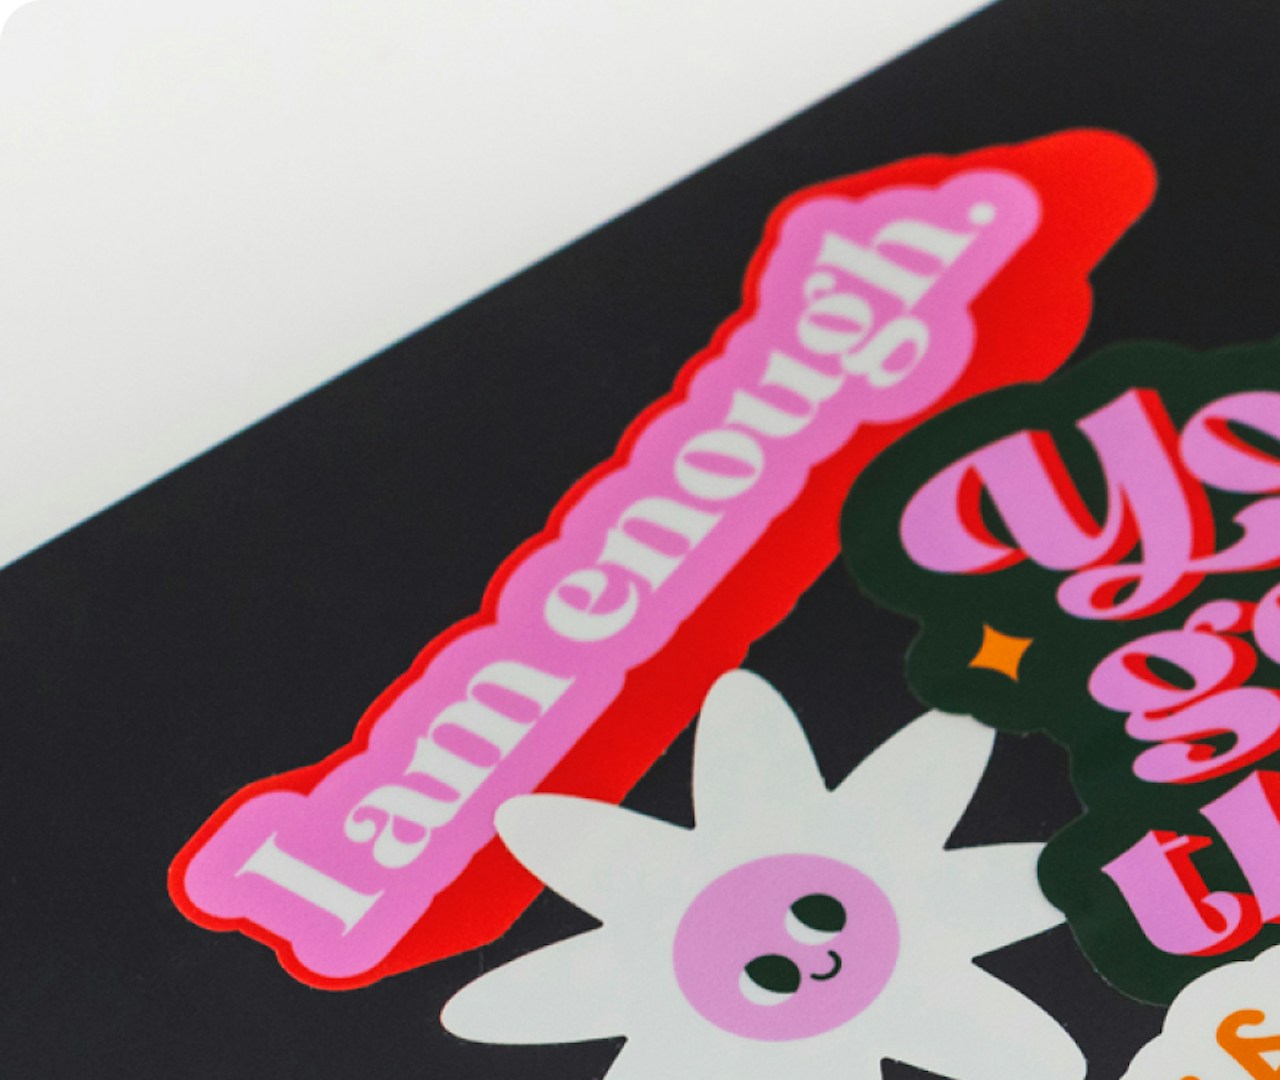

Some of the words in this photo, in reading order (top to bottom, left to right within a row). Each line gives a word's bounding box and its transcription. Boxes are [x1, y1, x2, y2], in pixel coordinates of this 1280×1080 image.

[234, 831, 386, 936] I
[342, 658, 577, 871] am
[543, 201, 996, 642] enough.
